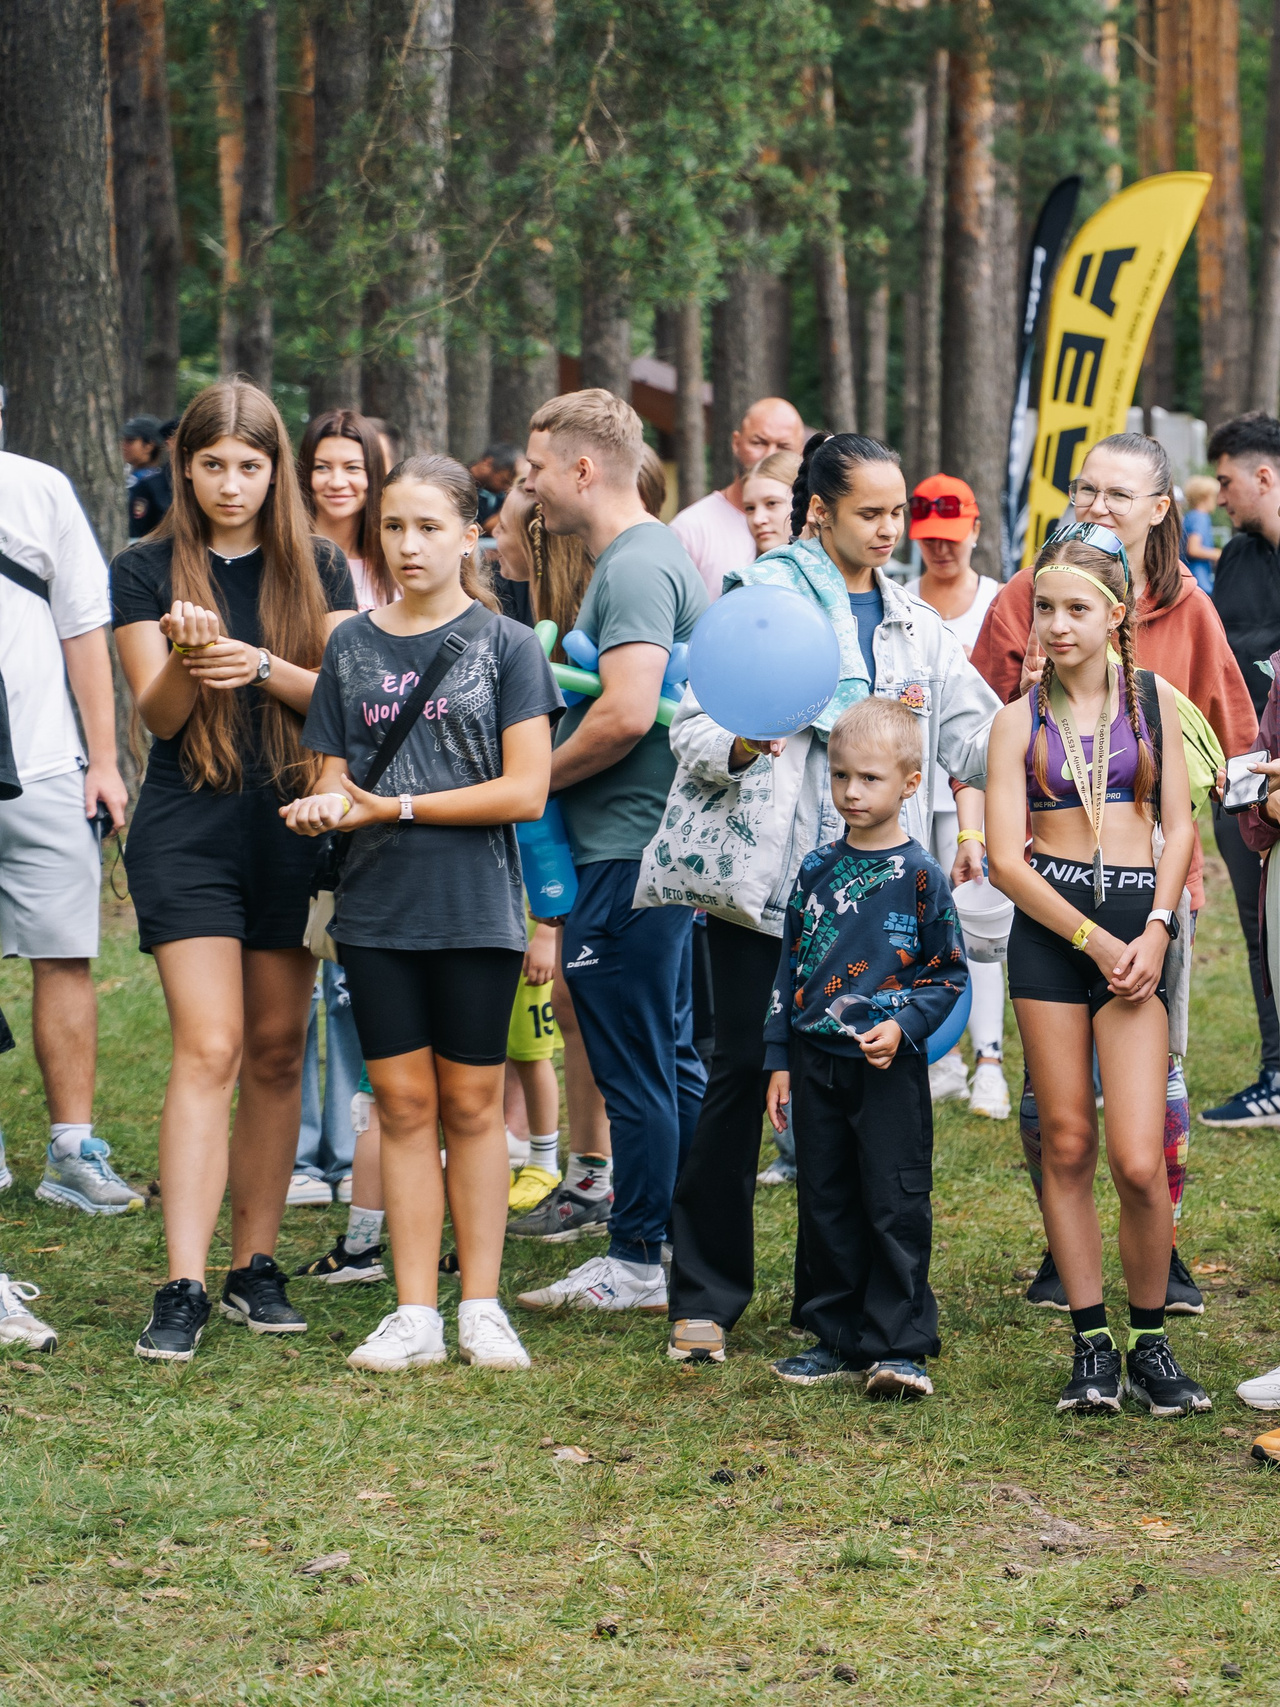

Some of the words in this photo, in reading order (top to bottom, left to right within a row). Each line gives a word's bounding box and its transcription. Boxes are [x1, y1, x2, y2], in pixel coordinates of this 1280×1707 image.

[382, 671, 421, 696] EPI
[362, 697, 449, 727] WONER
[766, 695, 830, 730] ANKOVA
[1061, 718, 1076, 753] FEST2025
[1098, 724, 1106, 764] Footbolika
[1073, 755, 1082, 779] Family
[1096, 765, 1104, 790] Family
[1044, 800, 1057, 808] PRO
[1106, 792, 1122, 800] PRO
[1118, 871, 1157, 889] PR
[662, 886, 684, 901] ЛЕТО
[566, 957, 600, 969] DEMIX
[528, 1000, 555, 1038] 19
